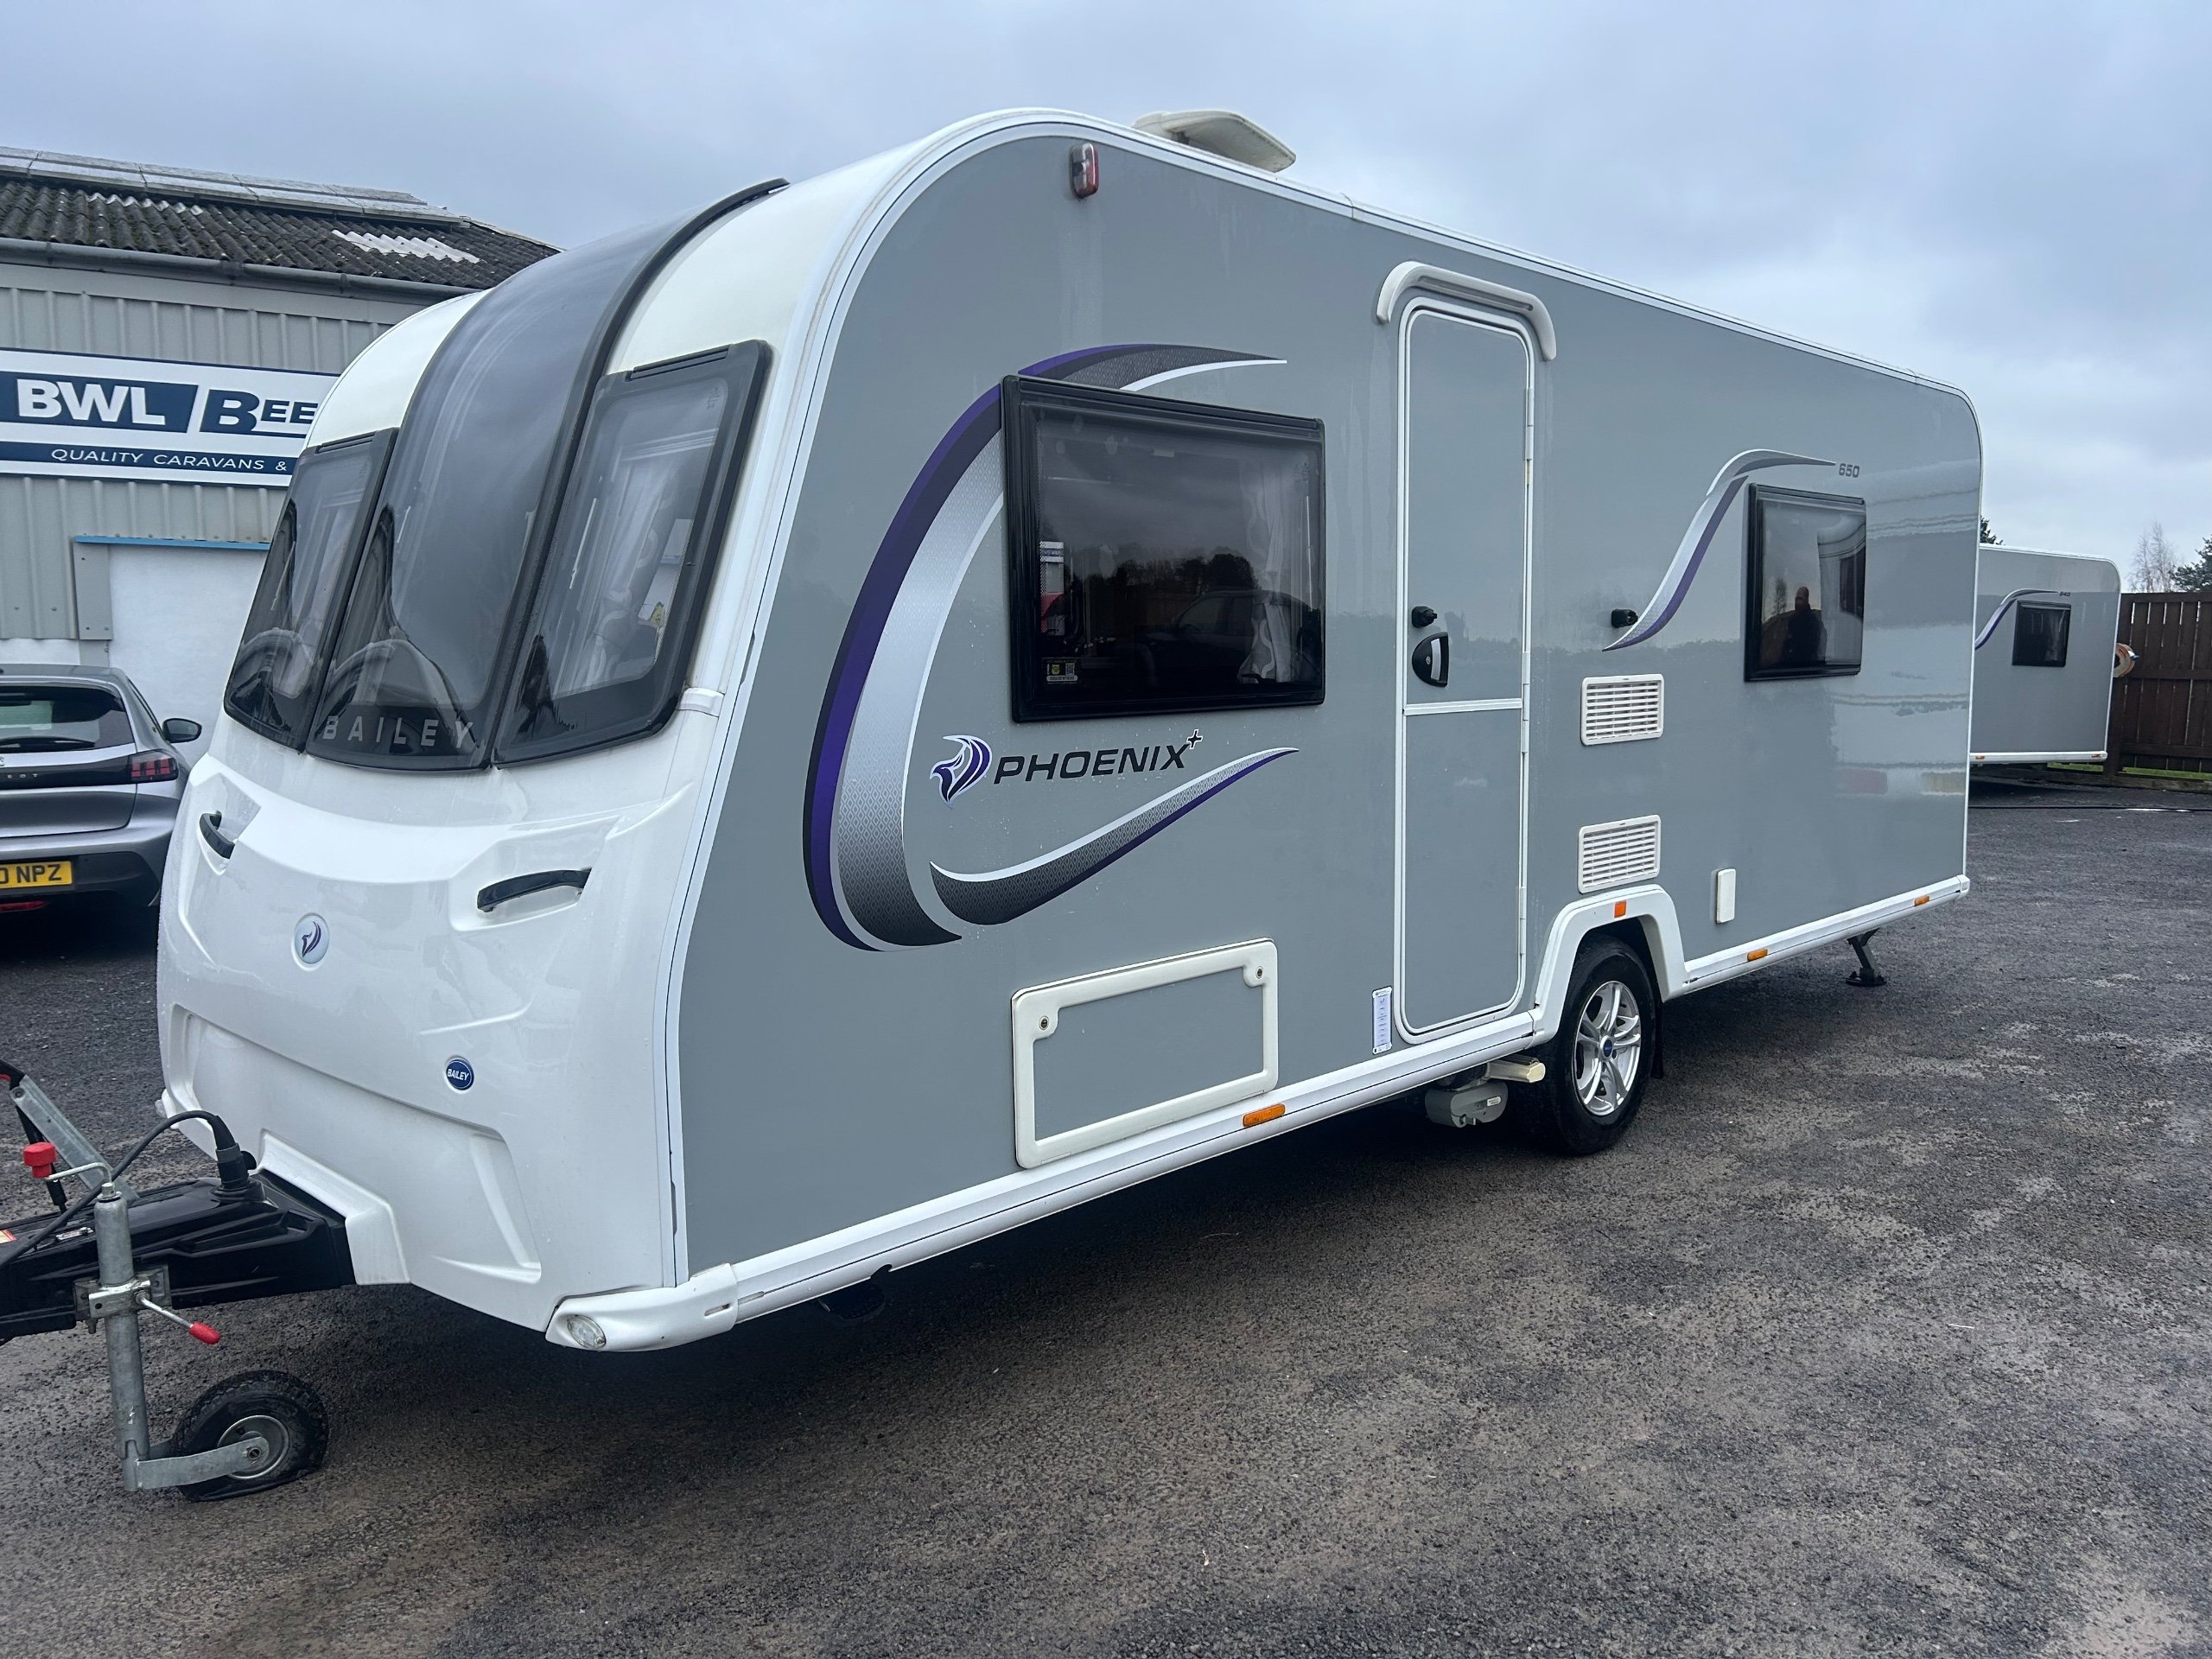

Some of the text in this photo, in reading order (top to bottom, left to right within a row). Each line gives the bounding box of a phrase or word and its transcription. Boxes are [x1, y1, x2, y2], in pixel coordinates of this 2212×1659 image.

[17, 378, 166, 425] BWL
[51, 448, 287, 471] QUALITY CARAVANS &
[1839, 463, 1859, 478] 650
[322, 715, 474, 748] BAILEY
[16, 864, 61, 883] NPZ
[448, 1069, 469, 1080] BAILEY
